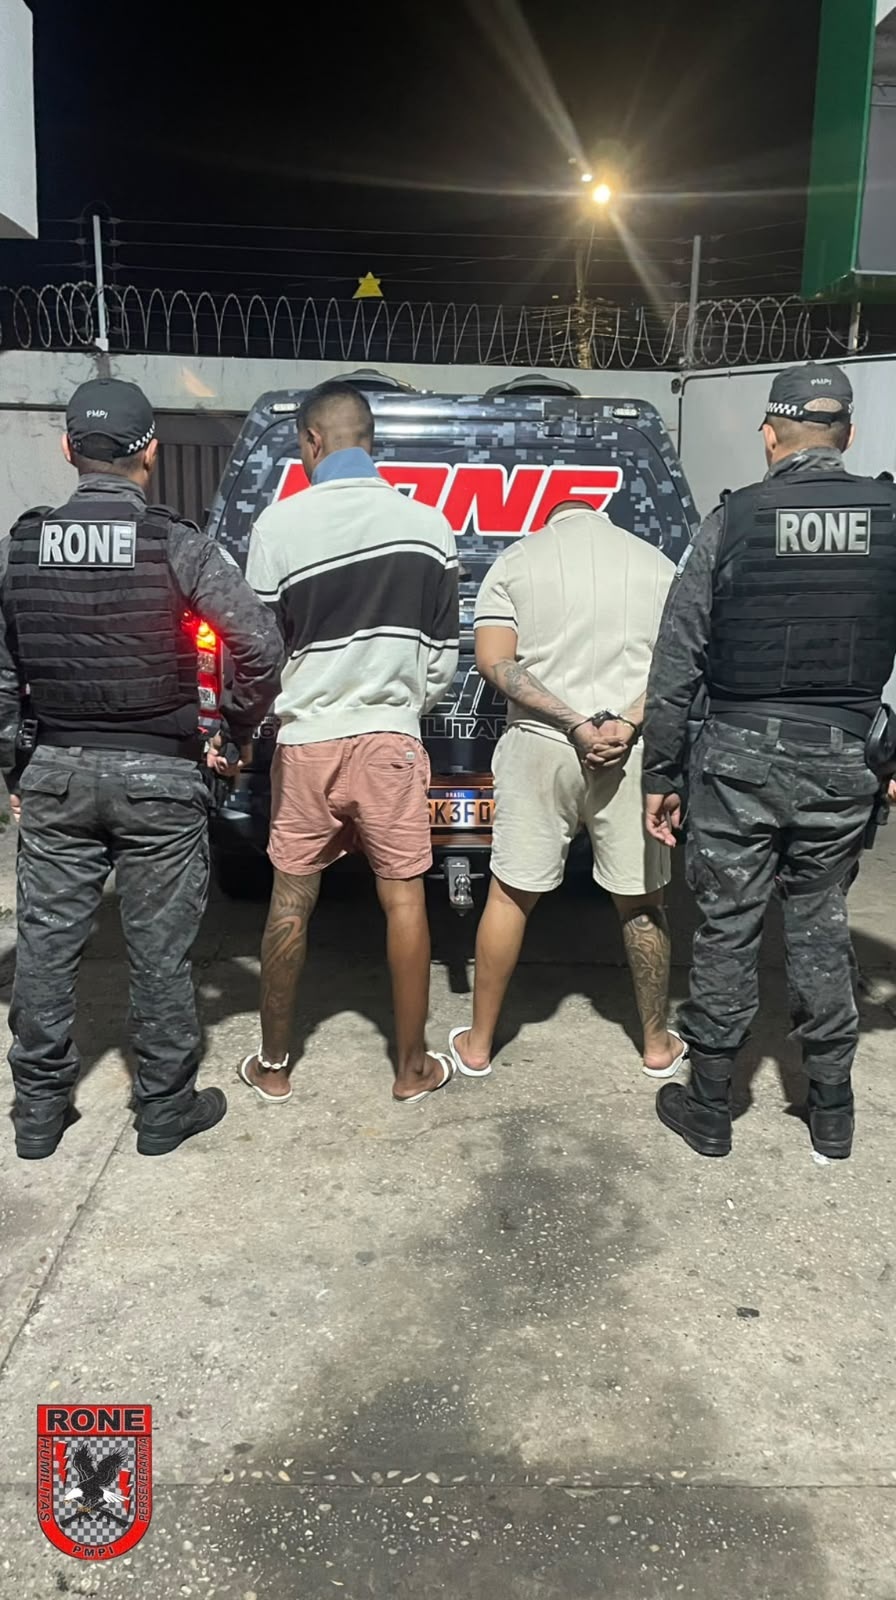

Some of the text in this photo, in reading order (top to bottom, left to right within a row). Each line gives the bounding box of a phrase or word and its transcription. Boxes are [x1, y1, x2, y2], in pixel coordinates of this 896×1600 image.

[274, 459, 623, 537] ONE
[42, 523, 133, 564] RONE
[779, 512, 868, 553] RONE
[421, 717, 507, 739] ILITA
[428, 801, 496, 825] K3F0
